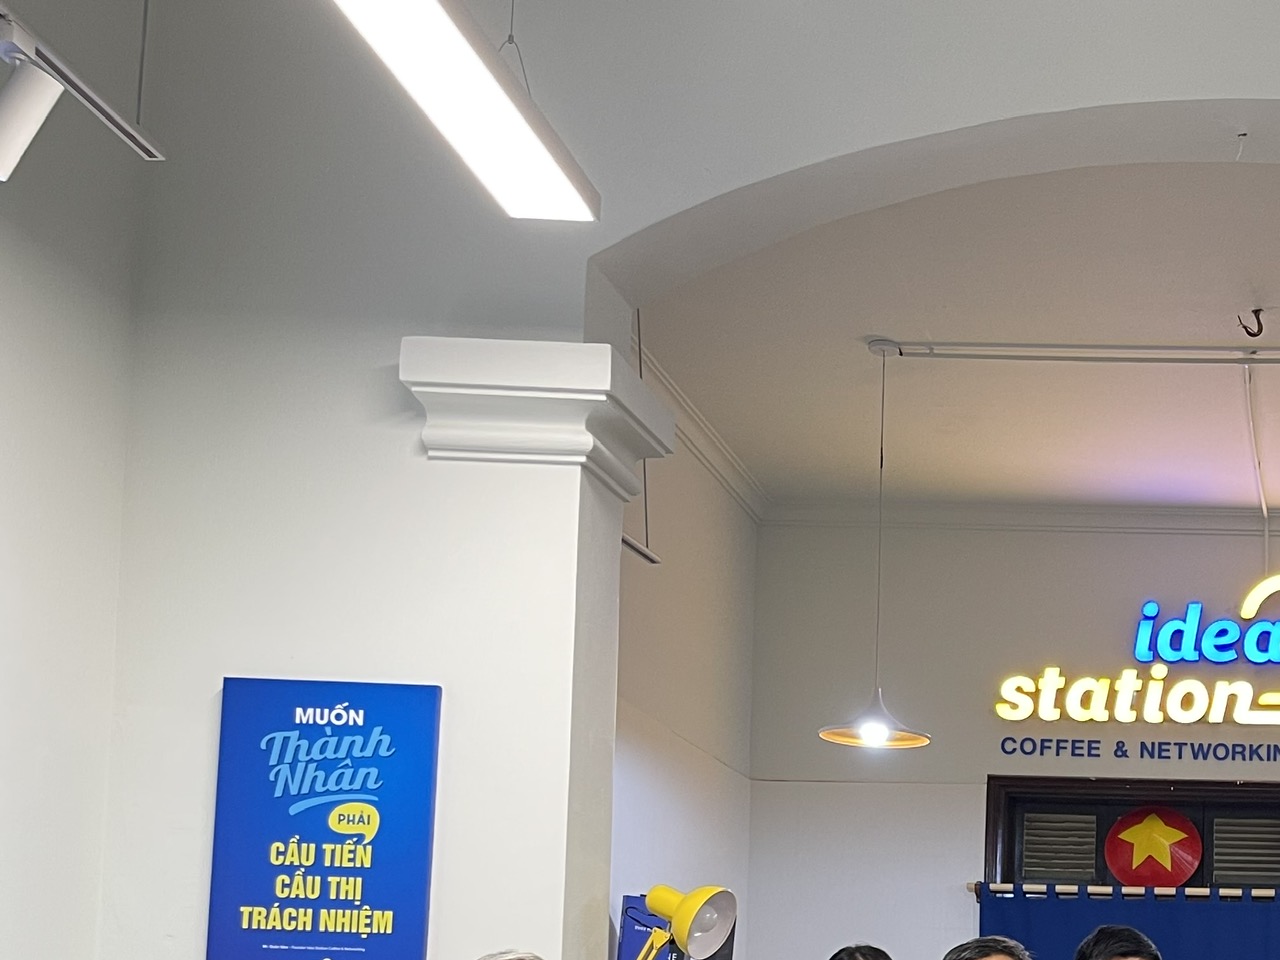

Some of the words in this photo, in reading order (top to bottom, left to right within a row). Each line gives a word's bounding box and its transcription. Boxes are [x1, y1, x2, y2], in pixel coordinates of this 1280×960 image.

[995, 664, 1254, 724] station
[295, 702, 364, 726] MUỐN
[260, 726, 395, 765] Thành
[1000, 736, 1101, 758] COFFEE
[1113, 740, 1130, 758] &
[269, 759, 383, 797] Nhân
[337, 811, 371, 825] PHẢI
[270, 835, 316, 866] CẦU
[322, 838, 372, 868] TIẾN
[275, 868, 321, 899] CẦU
[327, 876, 362, 905] THỊ
[240, 903, 313, 931] TRÁCH
[319, 905, 393, 938] NHIỆM
